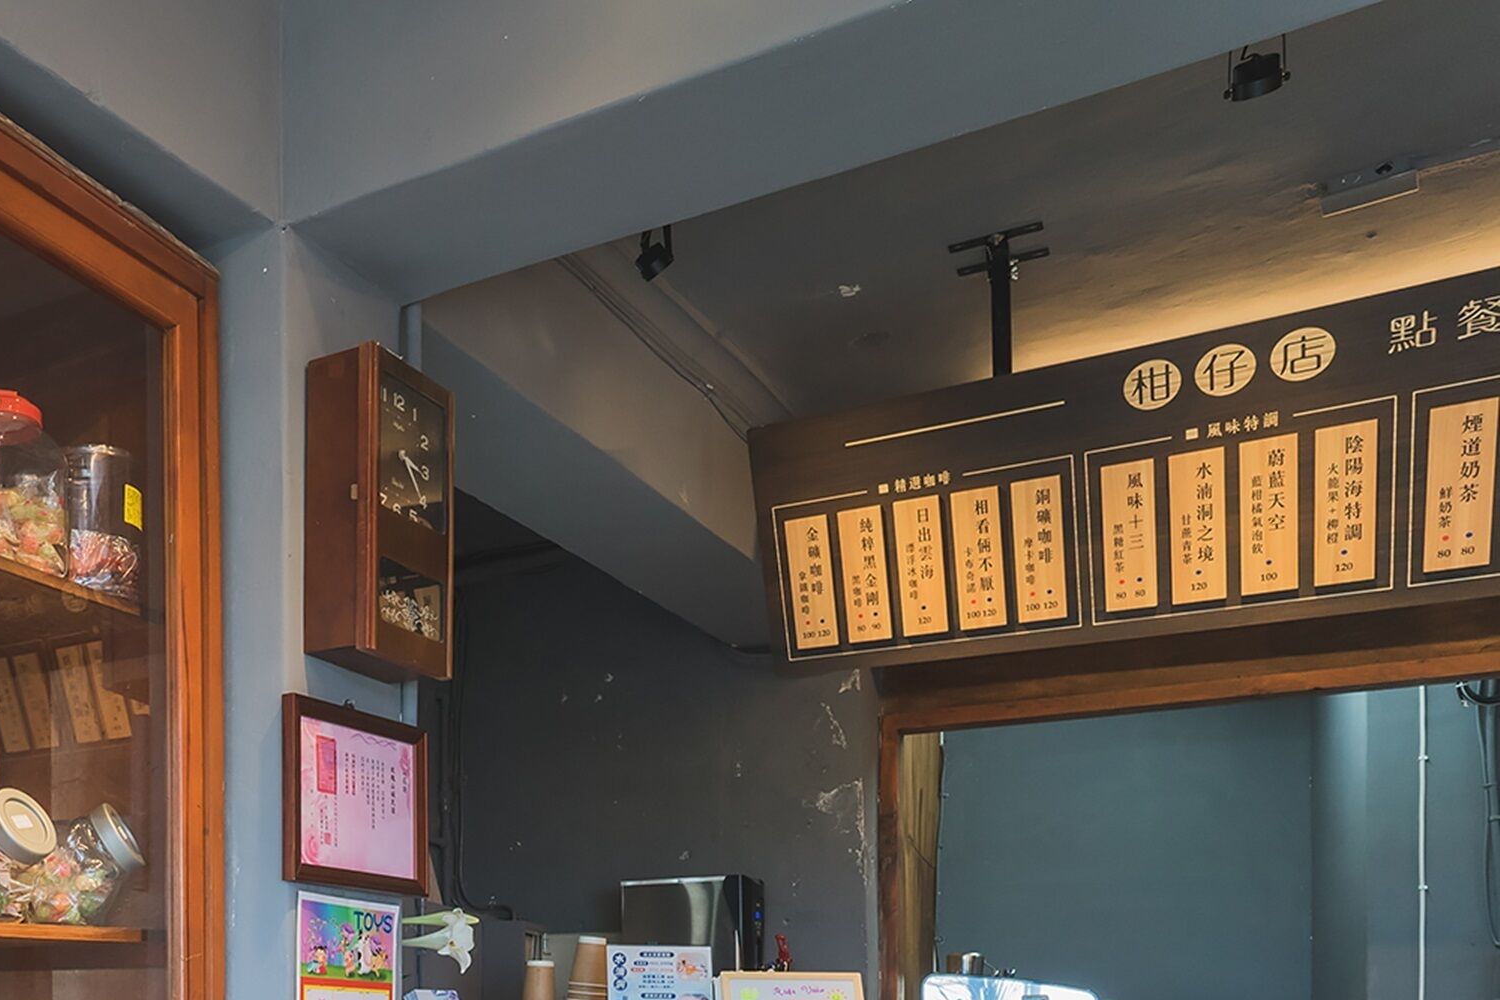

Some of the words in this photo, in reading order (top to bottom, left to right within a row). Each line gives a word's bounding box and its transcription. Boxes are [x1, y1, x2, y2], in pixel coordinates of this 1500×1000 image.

[1131, 336, 1330, 406] 柑仔店
[393, 392, 405, 412] 12
[1206, 411, 1281, 439] 風味特調
[420, 435, 429, 451] 2
[1459, 413, 1484, 504] 煙道奶茶
[421, 465, 430, 481] 3
[1267, 447, 1287, 532] 蔚藍天空
[1343, 434, 1365, 542] 陰陽海特調
[1127, 472, 1145, 551] 風味十三
[1195, 461, 1214, 563] 水湳洞之境
[1438, 486, 1452, 529] 鮮奶茶
[1035, 488, 1053, 564] 銅礦咖啡
[917, 508, 934, 580] 日出雲海
[974, 499, 995, 592] 相看倆不厭
[1437, 547, 1451, 559] 80
[1460, 545, 1475, 556] 80
[806, 526, 824, 595] 金礦咖啡
[859, 517, 880, 607] 純粹黑金剛
[1334, 561, 1353, 572] 120
[1190, 581, 1208, 592] 120
[1260, 571, 1278, 582] 100
[1025, 602, 1041, 612] 100
[1043, 600, 1058, 610] 120
[1115, 590, 1127, 600] 80
[1134, 588, 1146, 598] 80
[918, 616, 932, 625] 120
[966, 610, 981, 619] 100
[982, 608, 997, 618] 120
[802, 630, 816, 640] 100
[817, 629, 831, 638] 120
[353, 910, 394, 934] TOYS
